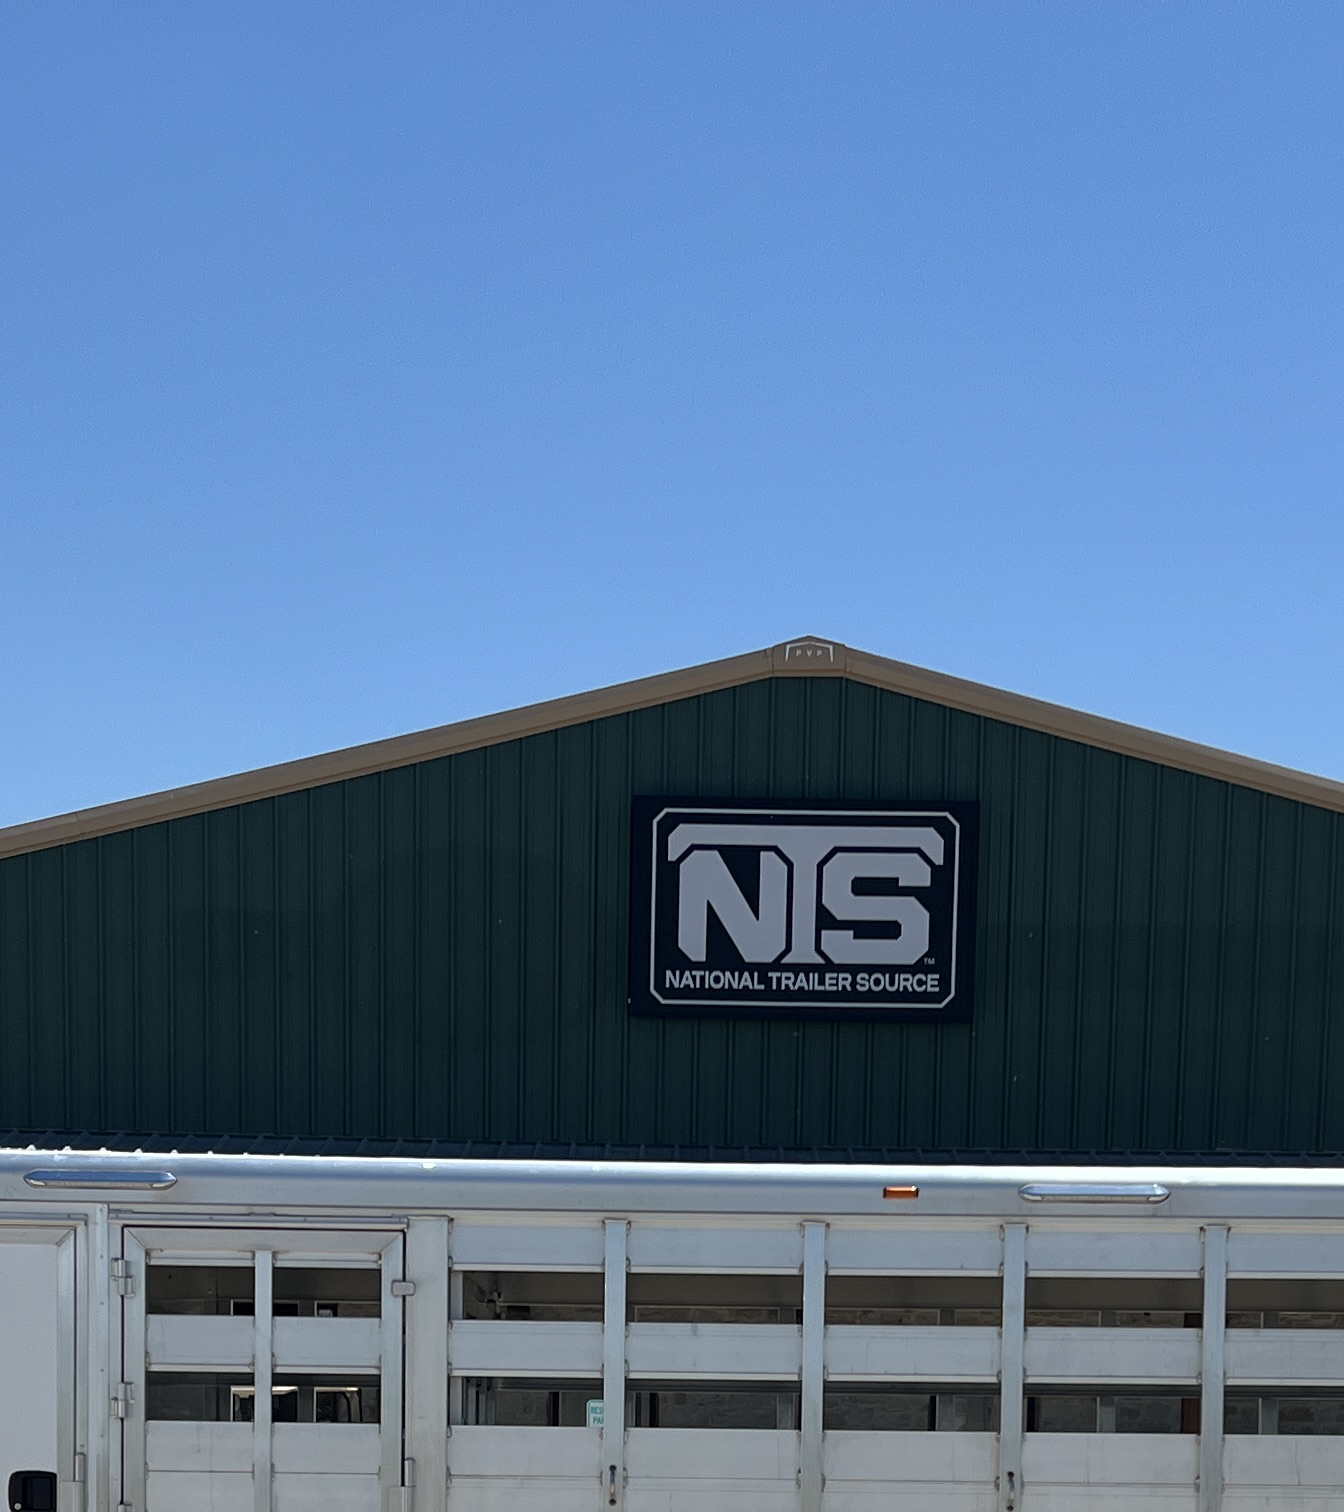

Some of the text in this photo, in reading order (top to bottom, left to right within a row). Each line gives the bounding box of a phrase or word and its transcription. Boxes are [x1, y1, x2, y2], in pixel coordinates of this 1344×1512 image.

[665, 969, 940, 993] NATIONAL TRAILER SOURCE
